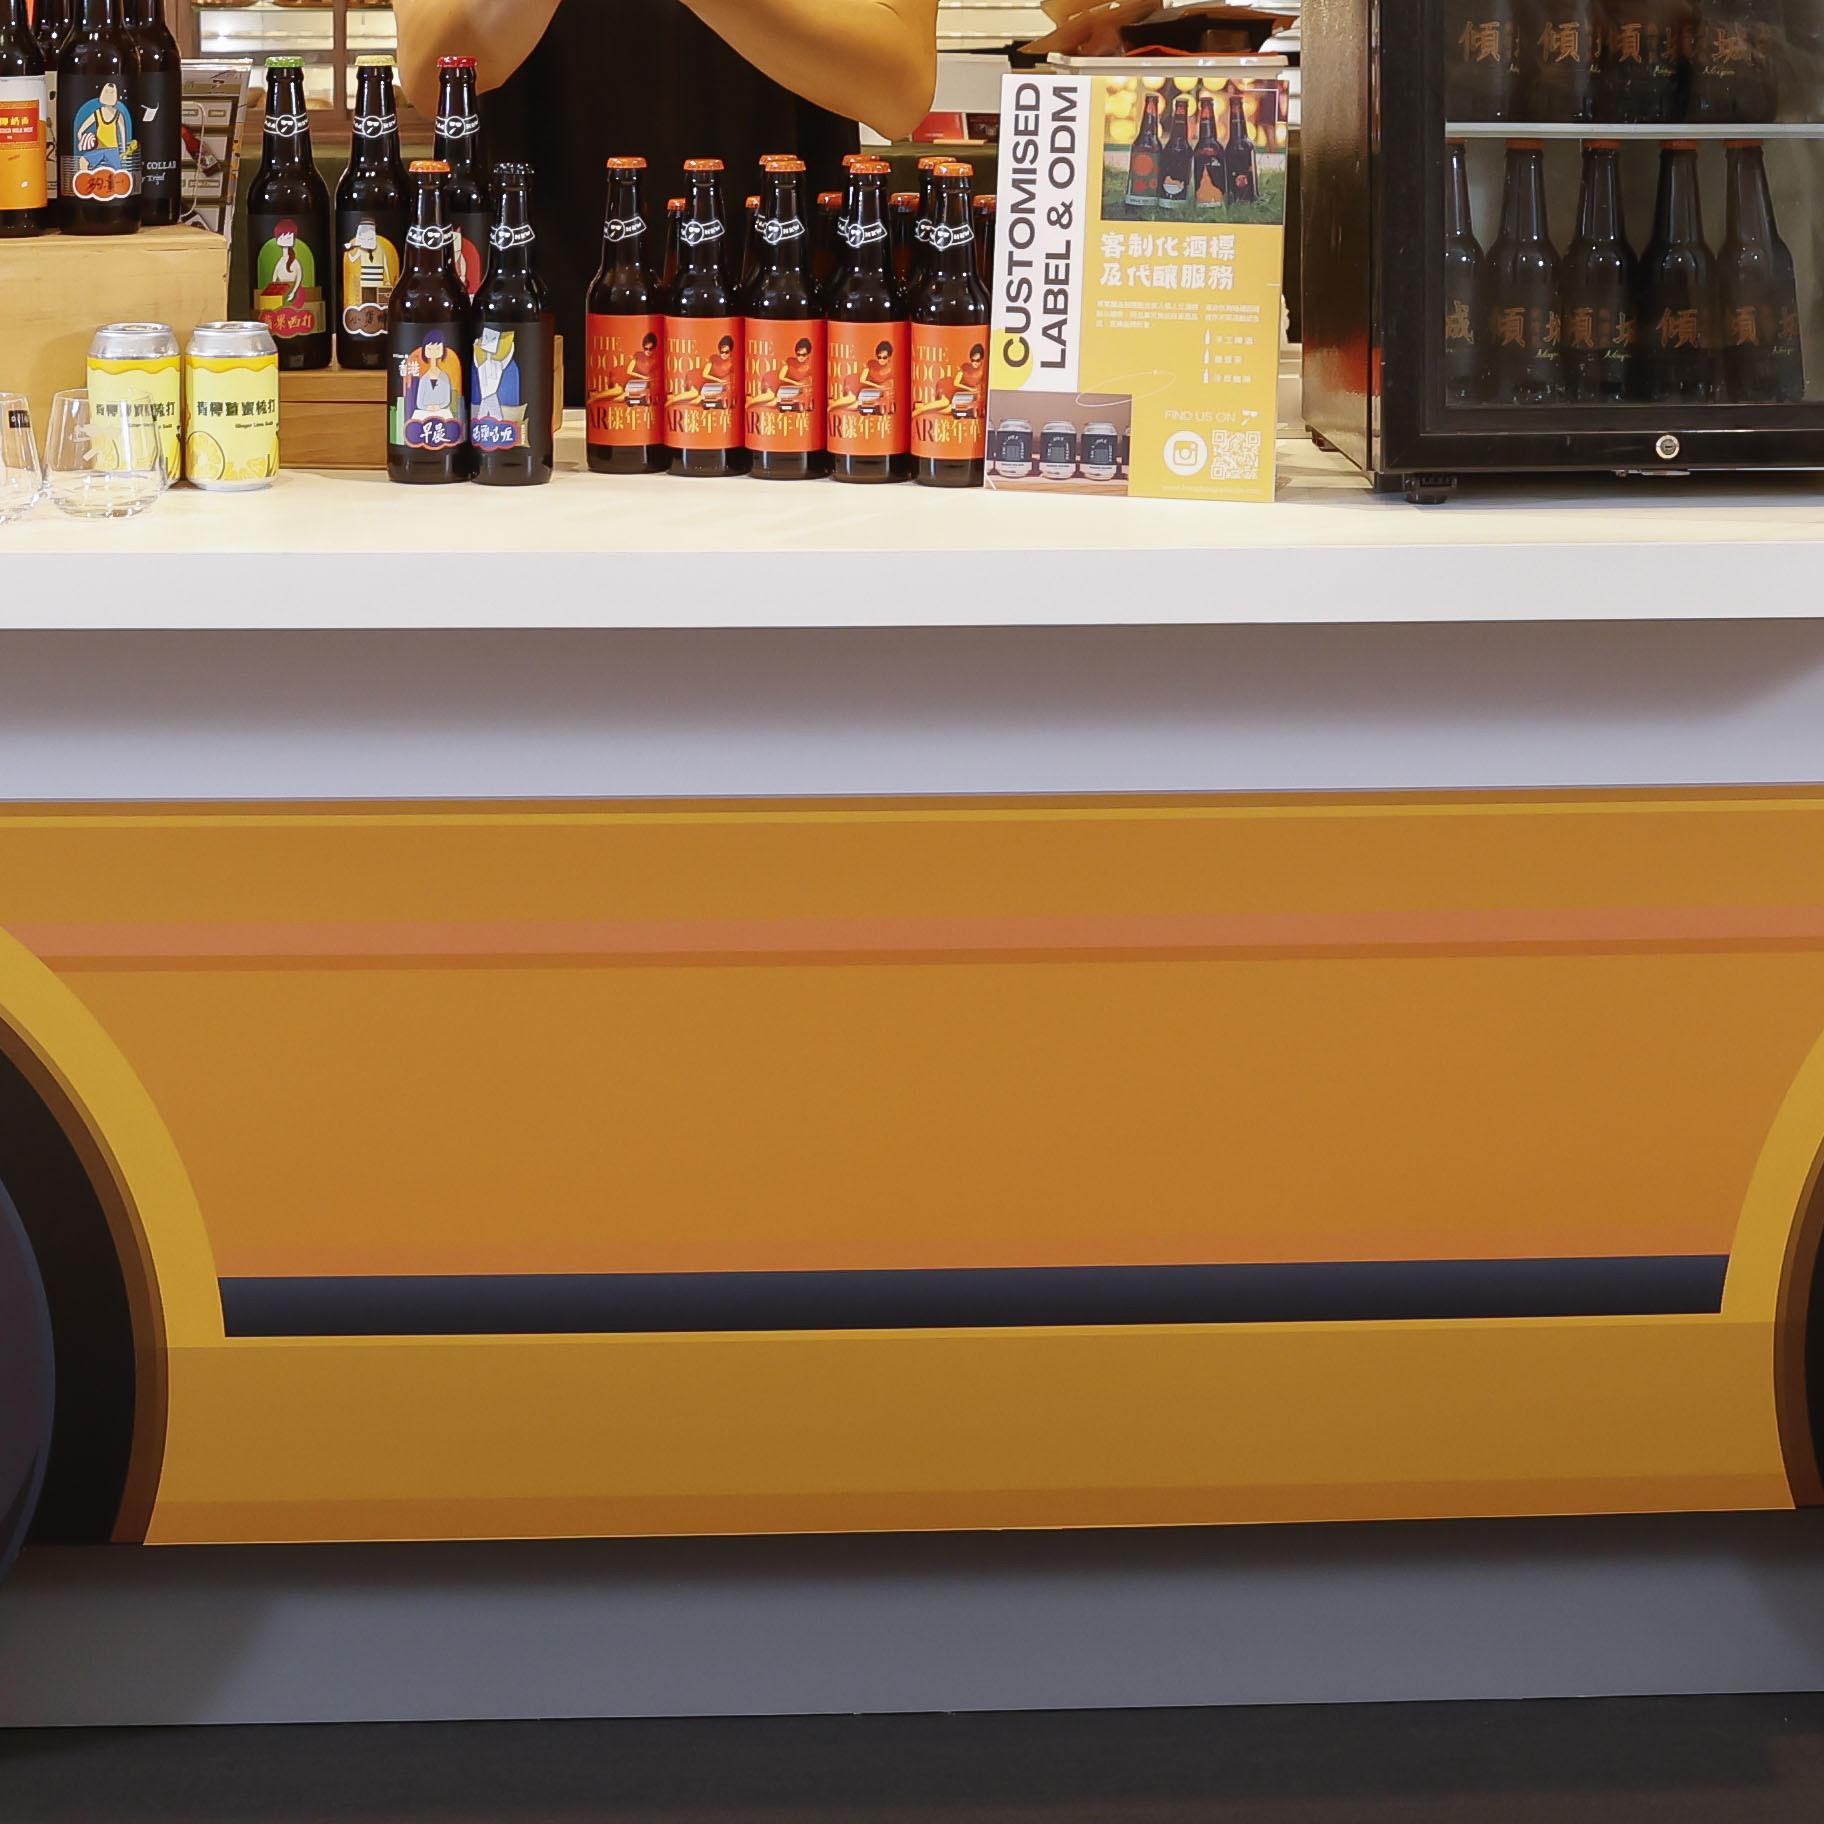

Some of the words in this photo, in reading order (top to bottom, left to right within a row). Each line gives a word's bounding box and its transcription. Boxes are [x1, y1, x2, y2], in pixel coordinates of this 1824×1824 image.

[1048, 86, 1078, 189] ODM
[1003, 82, 1041, 368] CUSTOMISED
[1046, 199, 1073, 230] &
[1040, 239, 1072, 369] LABEL
[1164, 409, 1192, 422] FIND
[1195, 410, 1213, 422] US
[1215, 412, 1236, 423] ON
